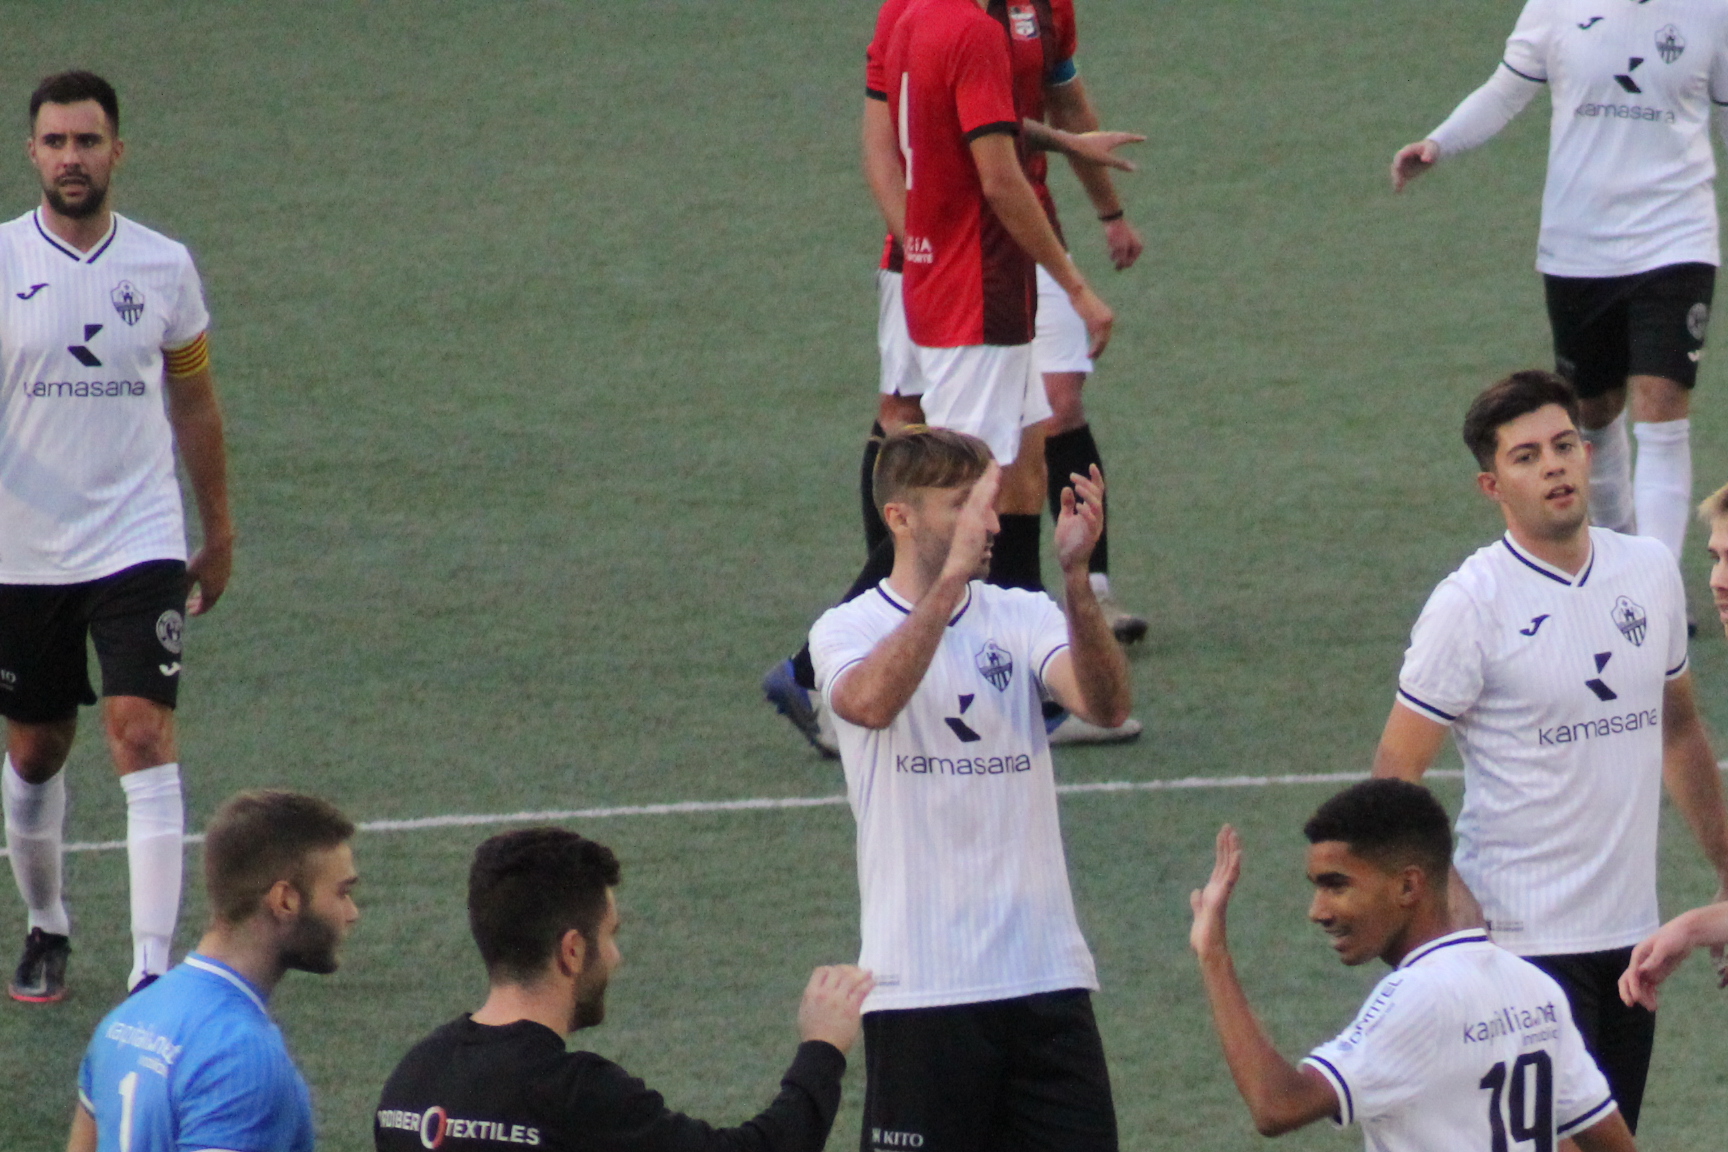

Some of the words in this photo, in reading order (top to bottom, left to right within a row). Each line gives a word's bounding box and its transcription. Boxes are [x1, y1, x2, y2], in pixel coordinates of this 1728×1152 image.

[1539, 708, 1658, 746] kamasana
[896, 754, 1031, 775] kamasana
[446, 1118, 541, 1146] TEXTILES
[884, 1130, 924, 1148] KITO
